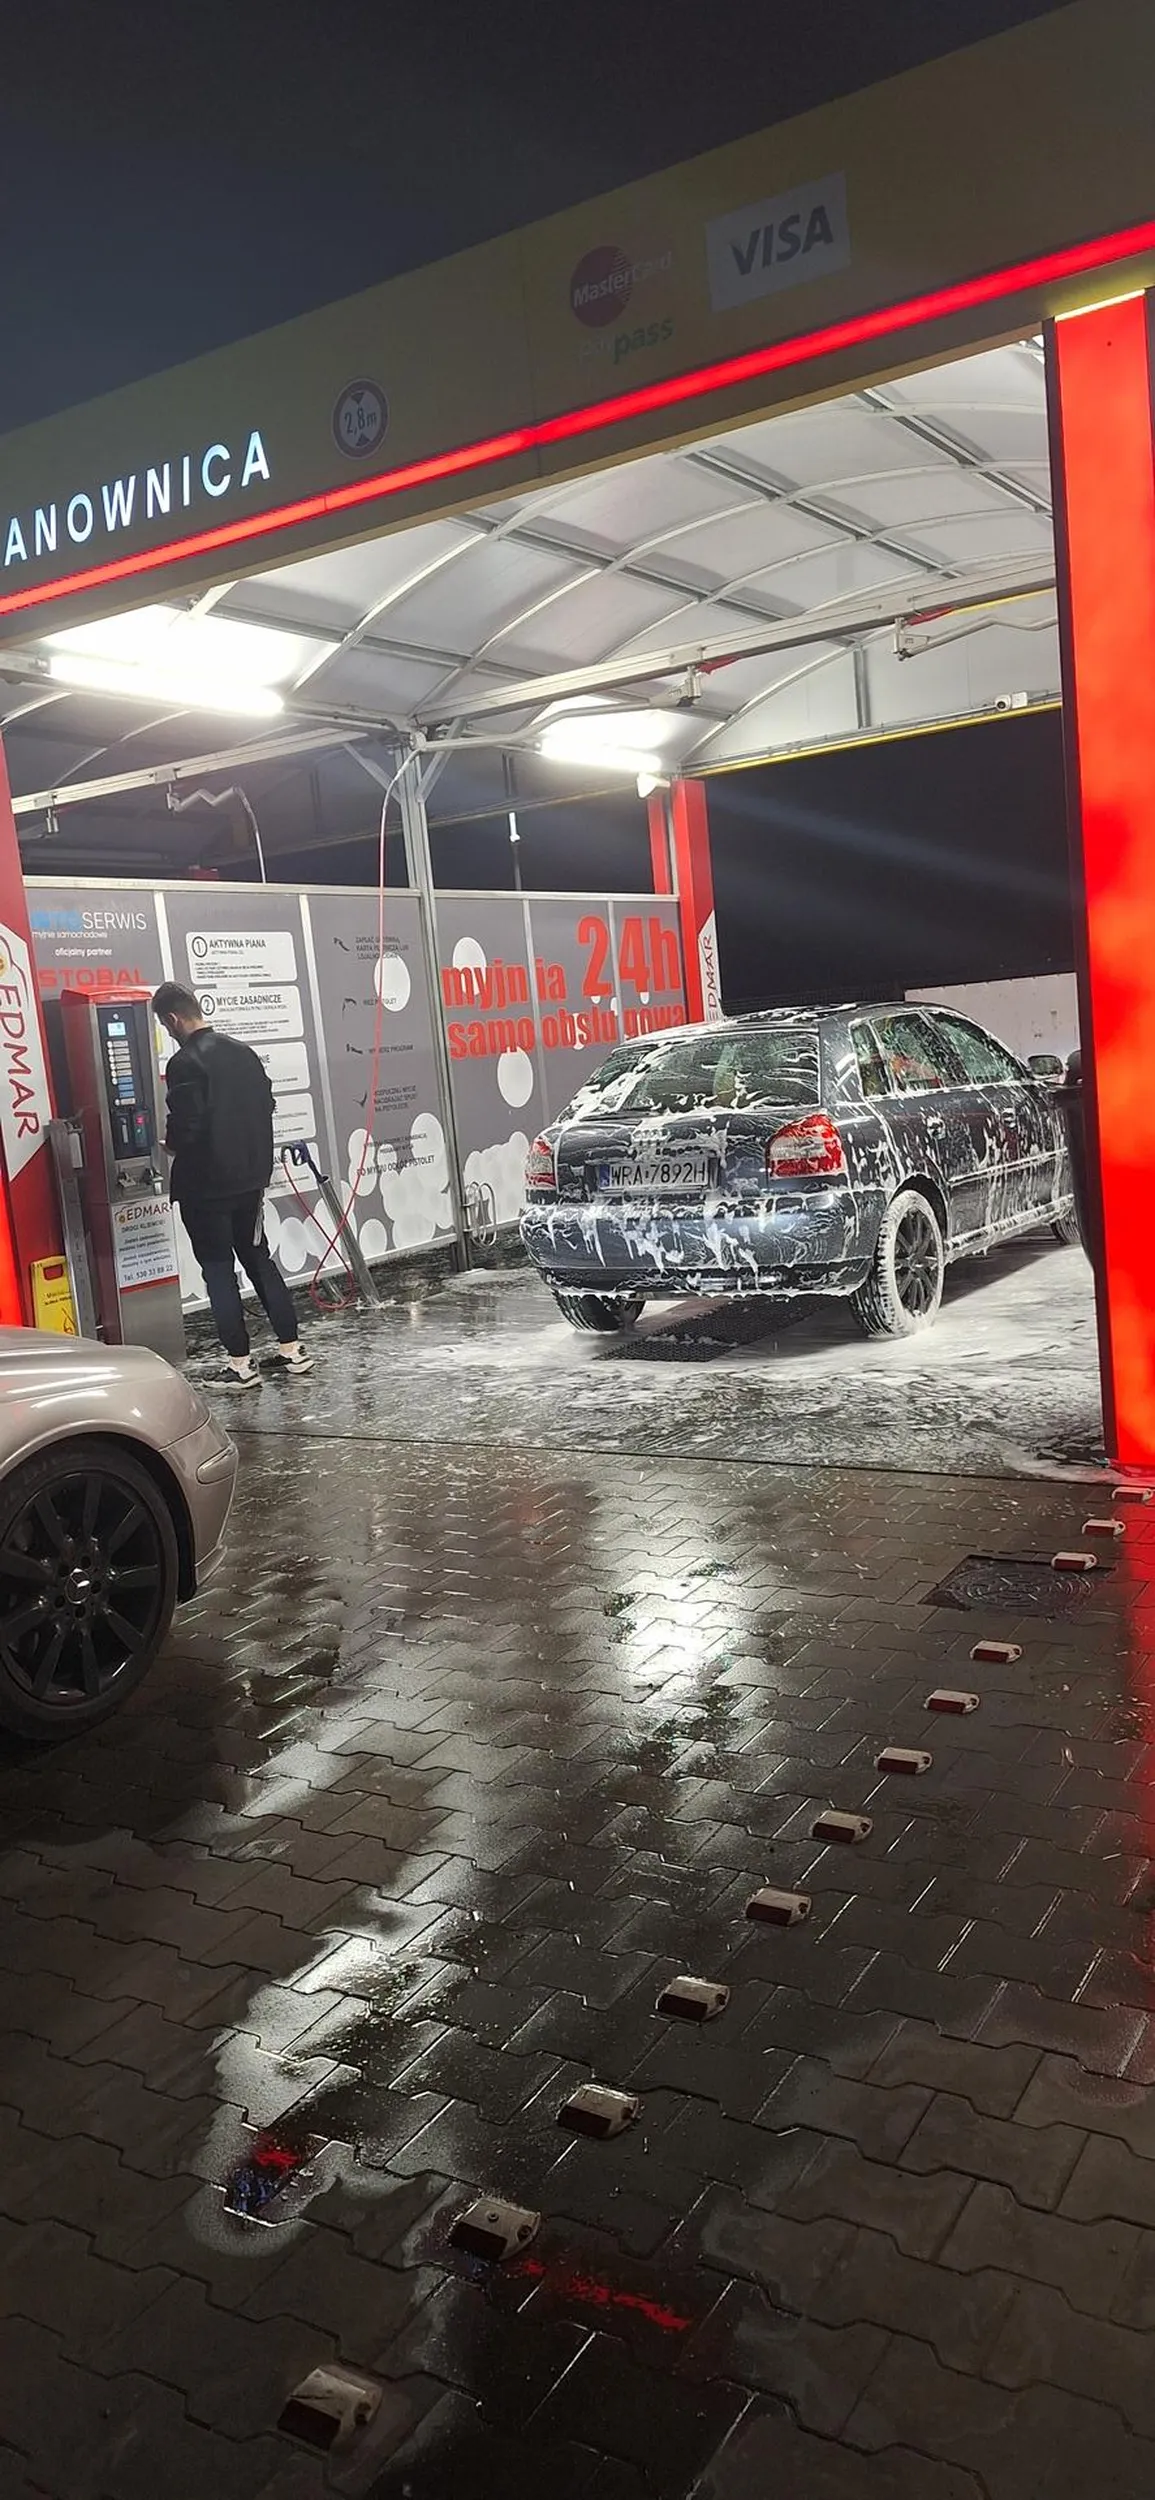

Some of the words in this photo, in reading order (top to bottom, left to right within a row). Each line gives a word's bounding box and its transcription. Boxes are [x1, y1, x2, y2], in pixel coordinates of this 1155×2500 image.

[730, 205, 833, 276] VISA
[573, 252, 672, 308] MasterCard
[4, 431, 270, 566] ANOWNICA
[86, 948, 112, 957] partner
[209, 939, 244, 948] AKTYWNA
[245, 939, 267, 948] PIANA
[577, 916, 681, 996] 24h
[216, 996, 239, 1006] MYCIE
[240, 994, 282, 1006] ZASADNICZE
[611, 1165, 643, 1186] WRA
[650, 1162, 706, 1183] 7892H
[126, 1202, 170, 1221] EDMAR
